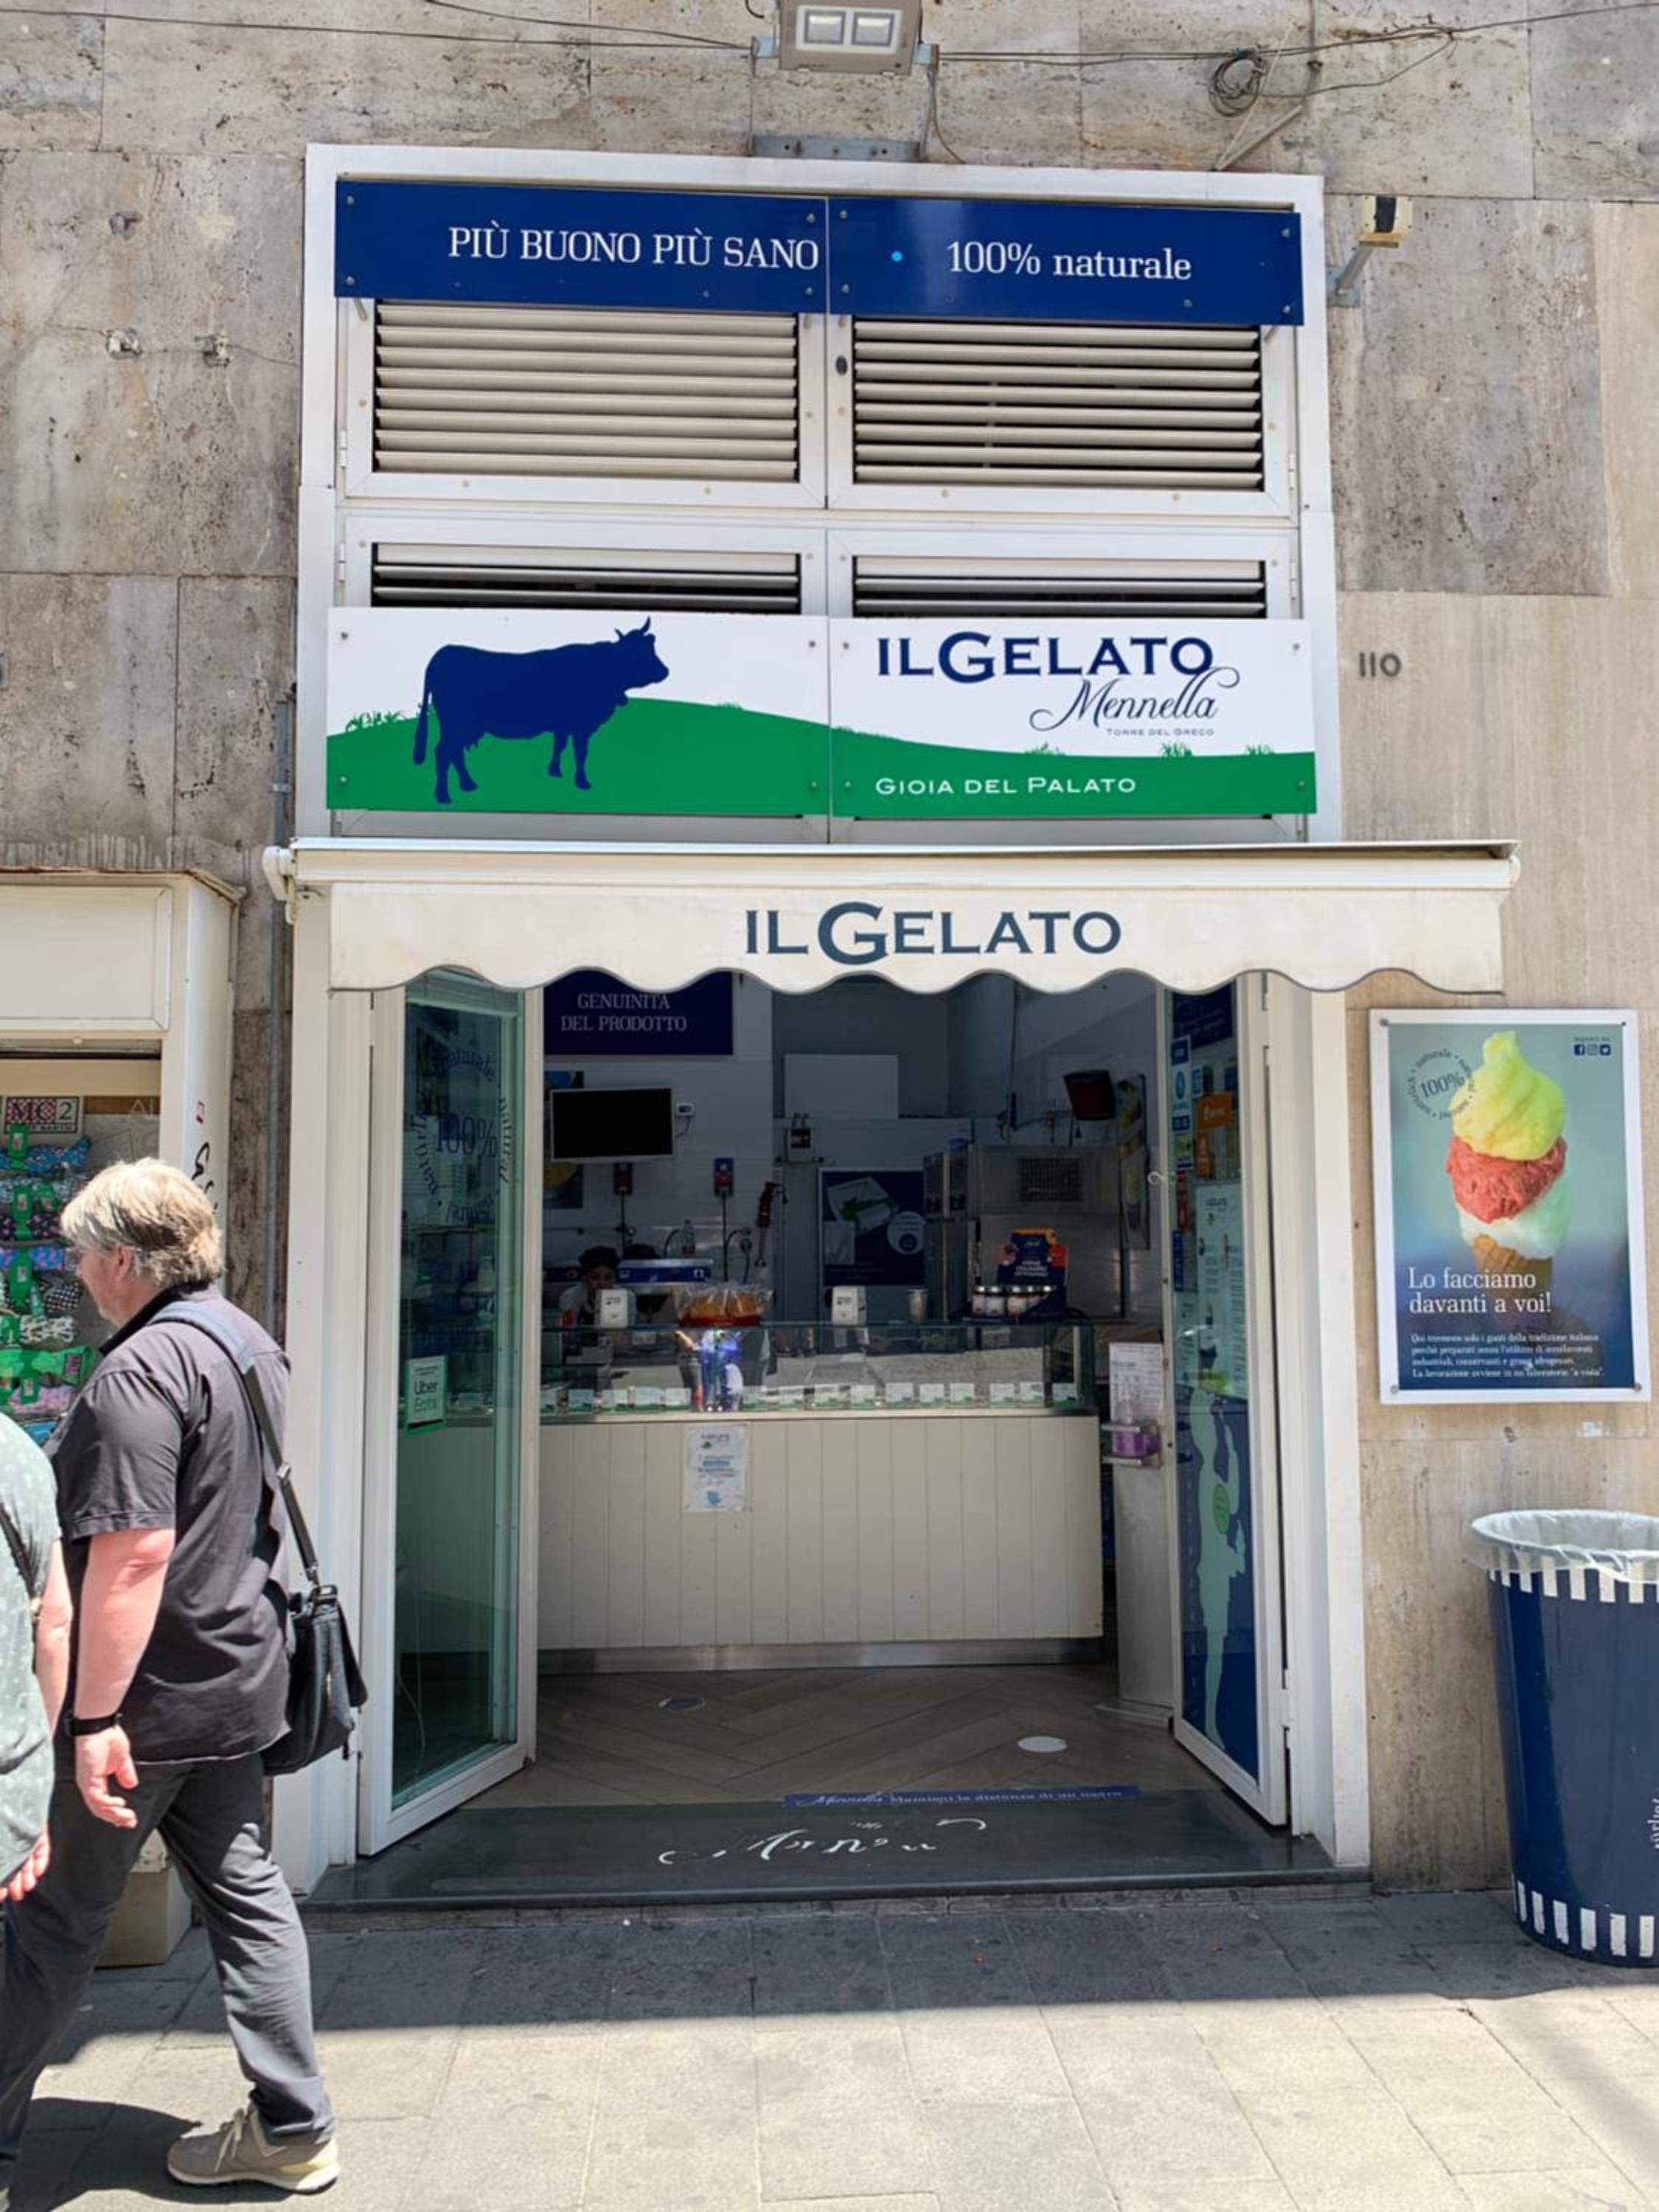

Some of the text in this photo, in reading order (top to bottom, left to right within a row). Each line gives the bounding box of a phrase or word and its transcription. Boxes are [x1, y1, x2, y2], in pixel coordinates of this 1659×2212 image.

[448, 219, 819, 271] PIÙ BUONO PIÙ SANO
[945, 240, 1192, 281] 100% naturale
[1358, 651, 1402, 679] 110
[1029, 666, 1241, 732] Mennella
[964, 778, 1018, 795] DEL
[560, 1015, 687, 1032] DEL PRODOTTO
[1420, 1072, 1466, 1098] 100%
[435, 1113, 498, 1157] 100%
[1409, 1266, 1537, 1290] Lo facciamo
[1408, 1292, 1552, 1314] davanti a voi!
